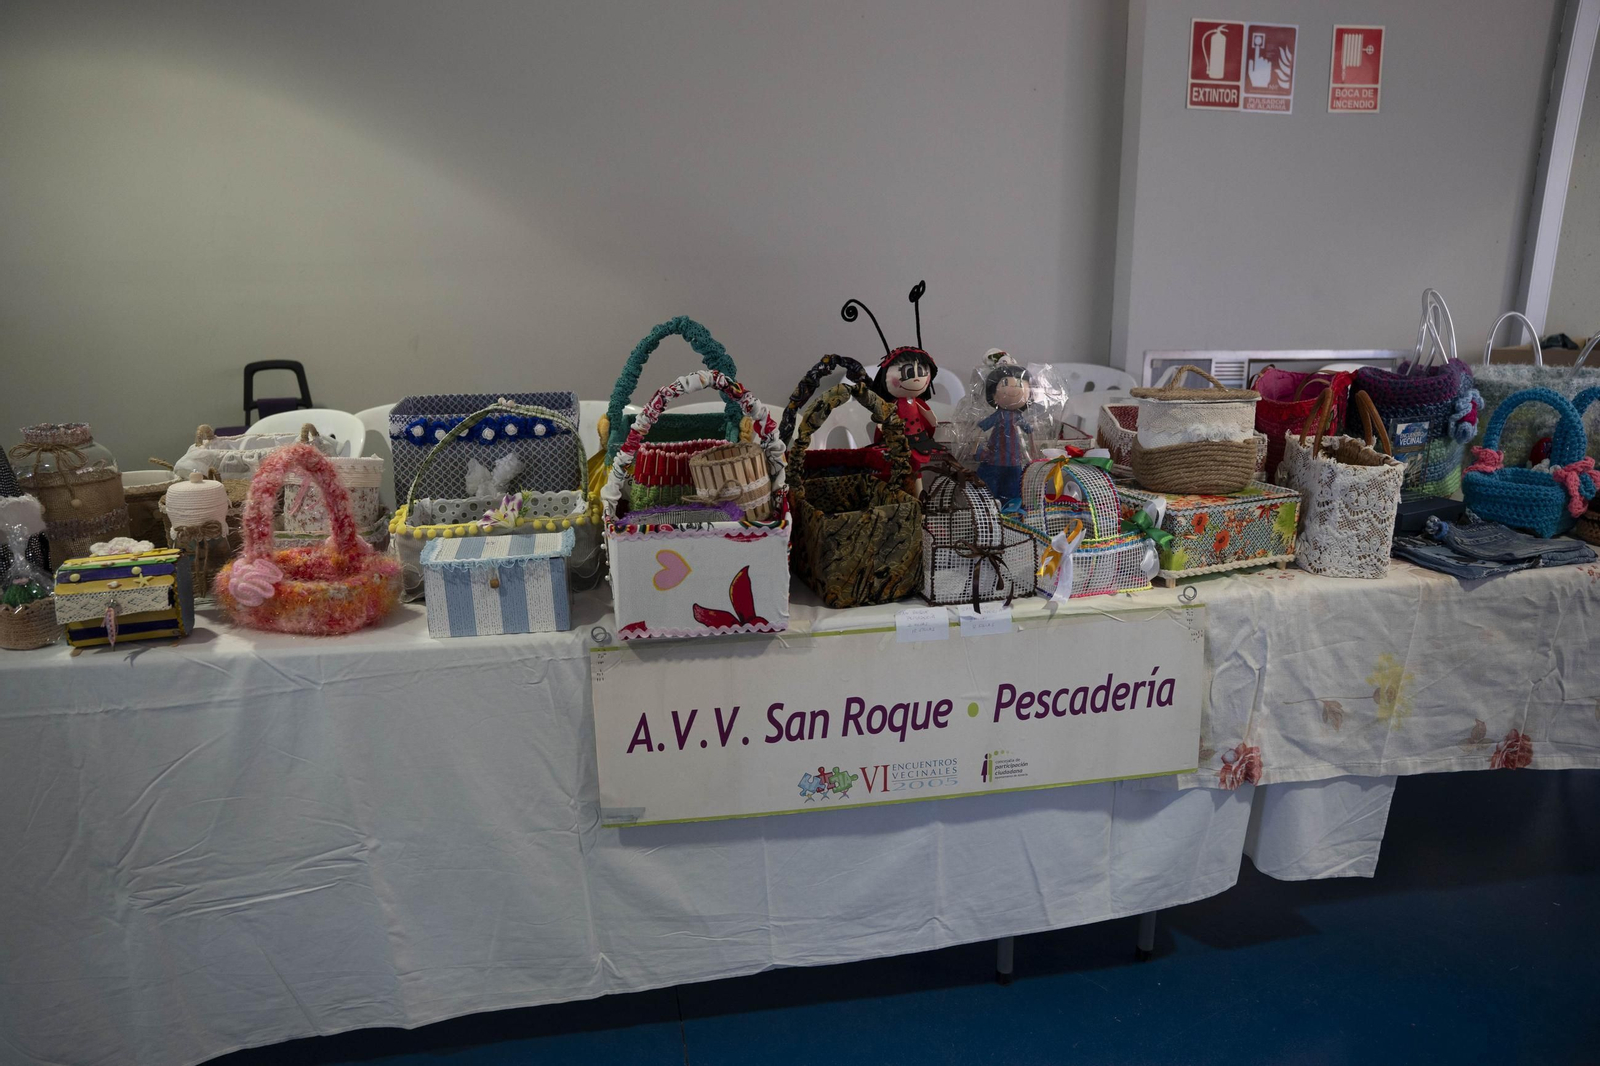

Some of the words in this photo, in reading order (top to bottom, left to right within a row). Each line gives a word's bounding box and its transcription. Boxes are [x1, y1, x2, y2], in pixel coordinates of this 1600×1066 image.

[1192, 87, 1238, 104] EXTINTOR
[1335, 88, 1360, 98] BOCA
[1362, 88, 1375, 98] DE
[1332, 100, 1375, 109] INCENDIO
[626, 706, 750, 754] A.V.V.
[764, 702, 830, 744] San
[841, 696, 954, 743] Roque
[993, 665, 1176, 723] Pescadería
[892, 758, 958, 772] ENCUENTROS
[994, 761, 1029, 771] participación
[994, 768, 1023, 776] ciudadana
[859, 764, 891, 794] VI
[892, 766, 958, 780] VECINALES
[891, 777, 959, 792] 2005
